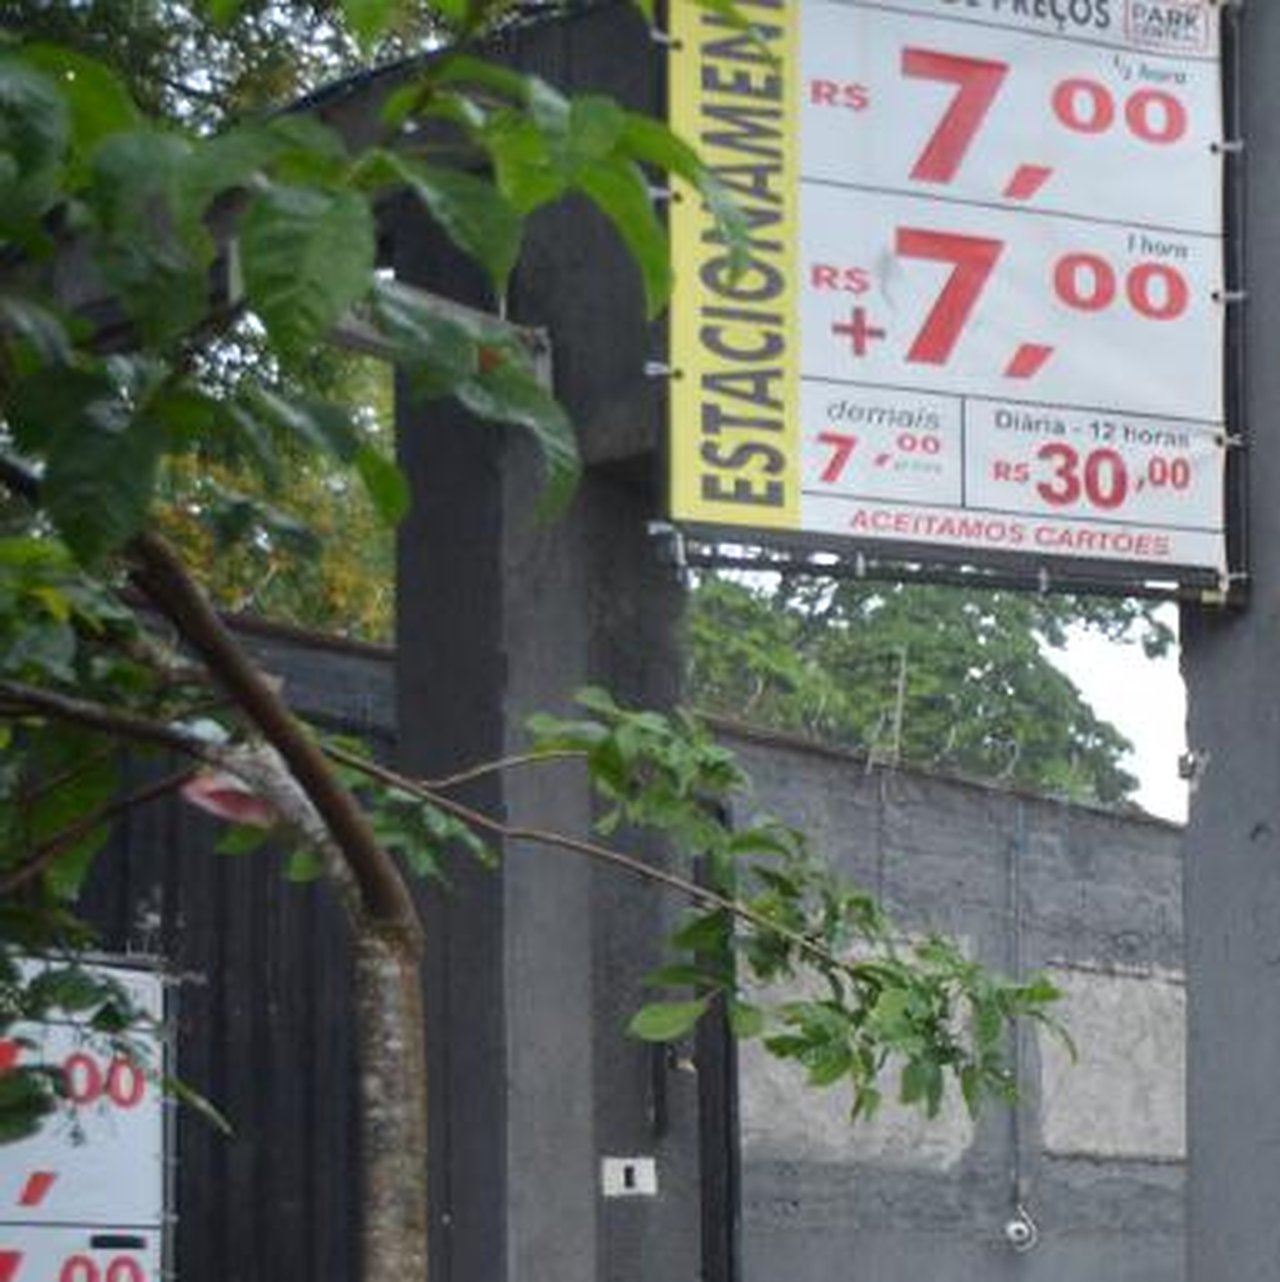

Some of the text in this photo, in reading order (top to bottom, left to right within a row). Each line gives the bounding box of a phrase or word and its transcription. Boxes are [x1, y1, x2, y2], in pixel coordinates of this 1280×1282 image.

[810, 79, 869, 111] R$
[700, 0, 785, 508] ESTACIONAMEN
[810, 265, 869, 294] R$
[827, 400, 940, 430] demais
[1089, 419, 1116, 440] 12
[1125, 422, 1190, 449] horas
[850, 508, 1026, 545] ACEITAMOS
